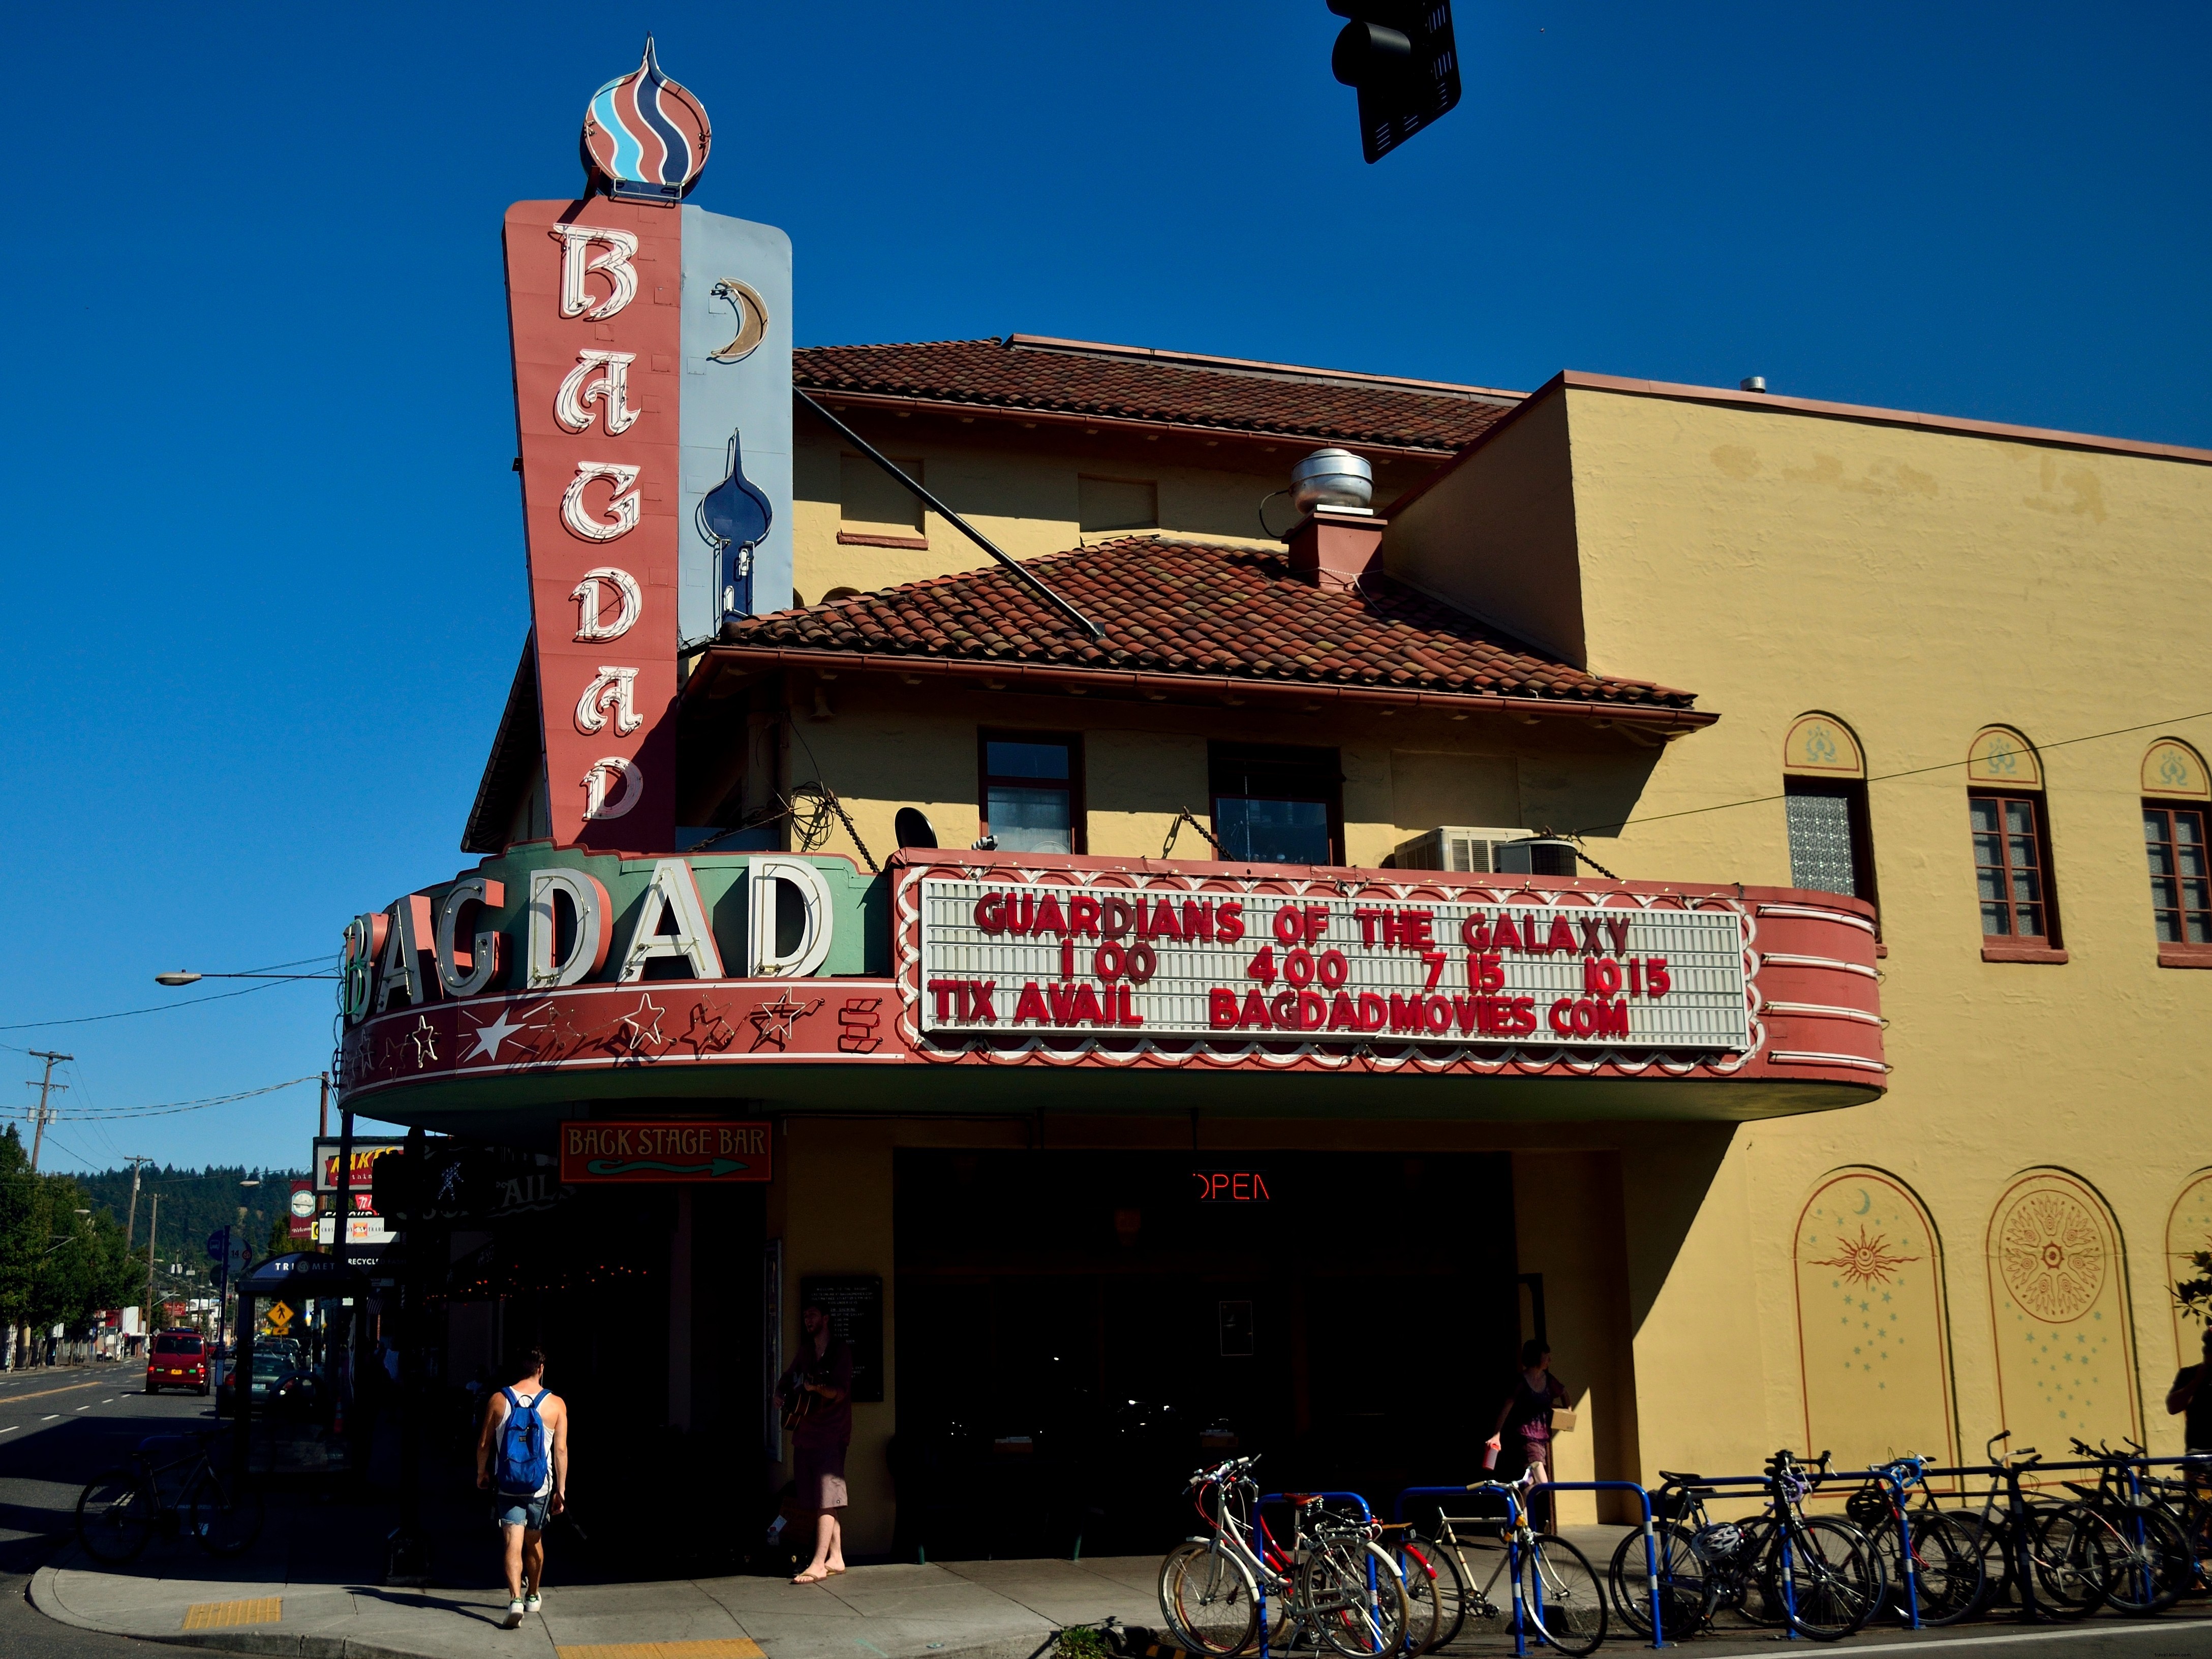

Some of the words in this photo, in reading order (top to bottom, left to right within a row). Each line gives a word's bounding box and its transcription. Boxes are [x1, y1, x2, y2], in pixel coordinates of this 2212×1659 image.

[554, 223, 643, 821] BAGDAD
[344, 856, 834, 1023] BAGDAD
[974, 892, 1245, 944] GUARDIANS
[1273, 904, 1330, 945] OF
[1354, 907, 1436, 951] THE
[1462, 912, 1631, 957] GALAXY
[928, 979, 998, 1025] TIX
[1013, 981, 1144, 1028] AVAIL
[1209, 987, 1538, 1037] BAGDADMOVIES
[1548, 997, 1630, 1039] COM
[568, 1128, 633, 1155] BACK
[637, 1128, 712, 1155] STAGE
[718, 1128, 766, 1154] BAR
[1193, 1173, 1270, 1200] OPEN
[275, 1262, 294, 1271] TRI
[312, 1262, 335, 1270] MET
